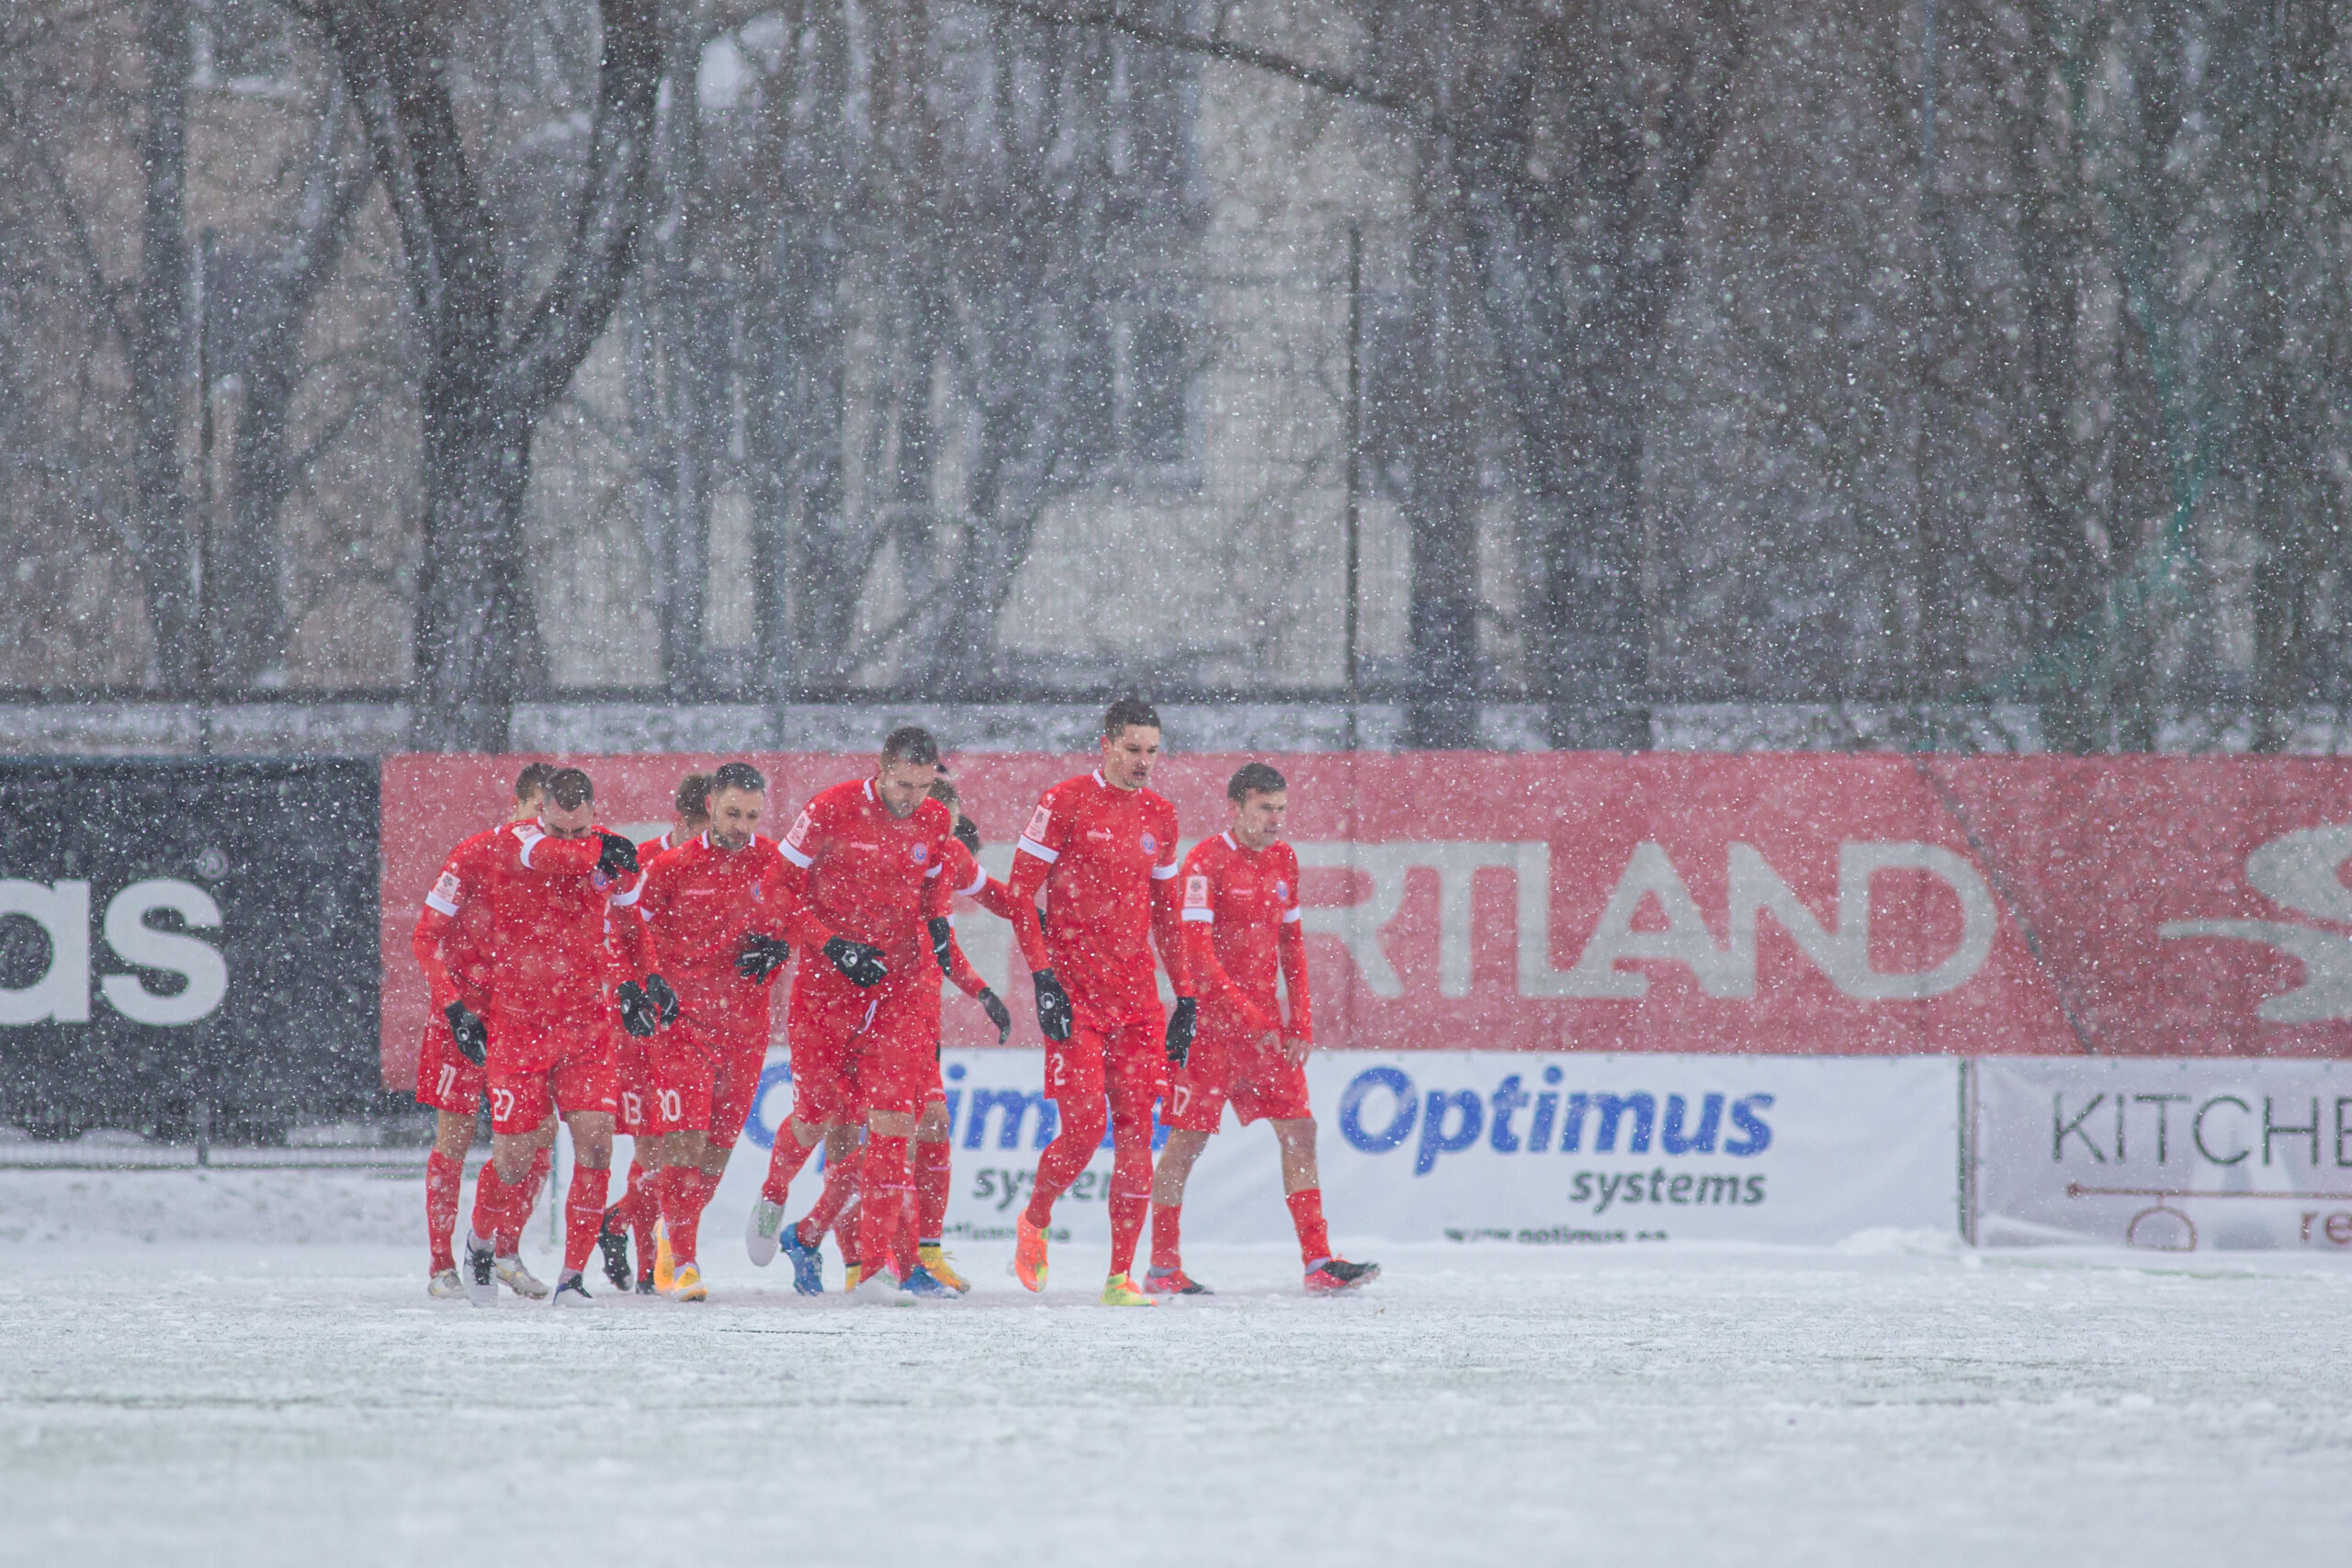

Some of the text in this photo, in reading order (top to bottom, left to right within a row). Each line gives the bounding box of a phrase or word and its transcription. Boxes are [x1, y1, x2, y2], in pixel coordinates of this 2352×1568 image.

[0, 878, 228, 1027] as
[436, 1064, 457, 1098] 11
[492, 1088, 514, 1122] 27
[622, 1091, 642, 1125] 13
[1339, 1065, 1776, 1177] Optimus
[1569, 1168, 1767, 1213] systems
